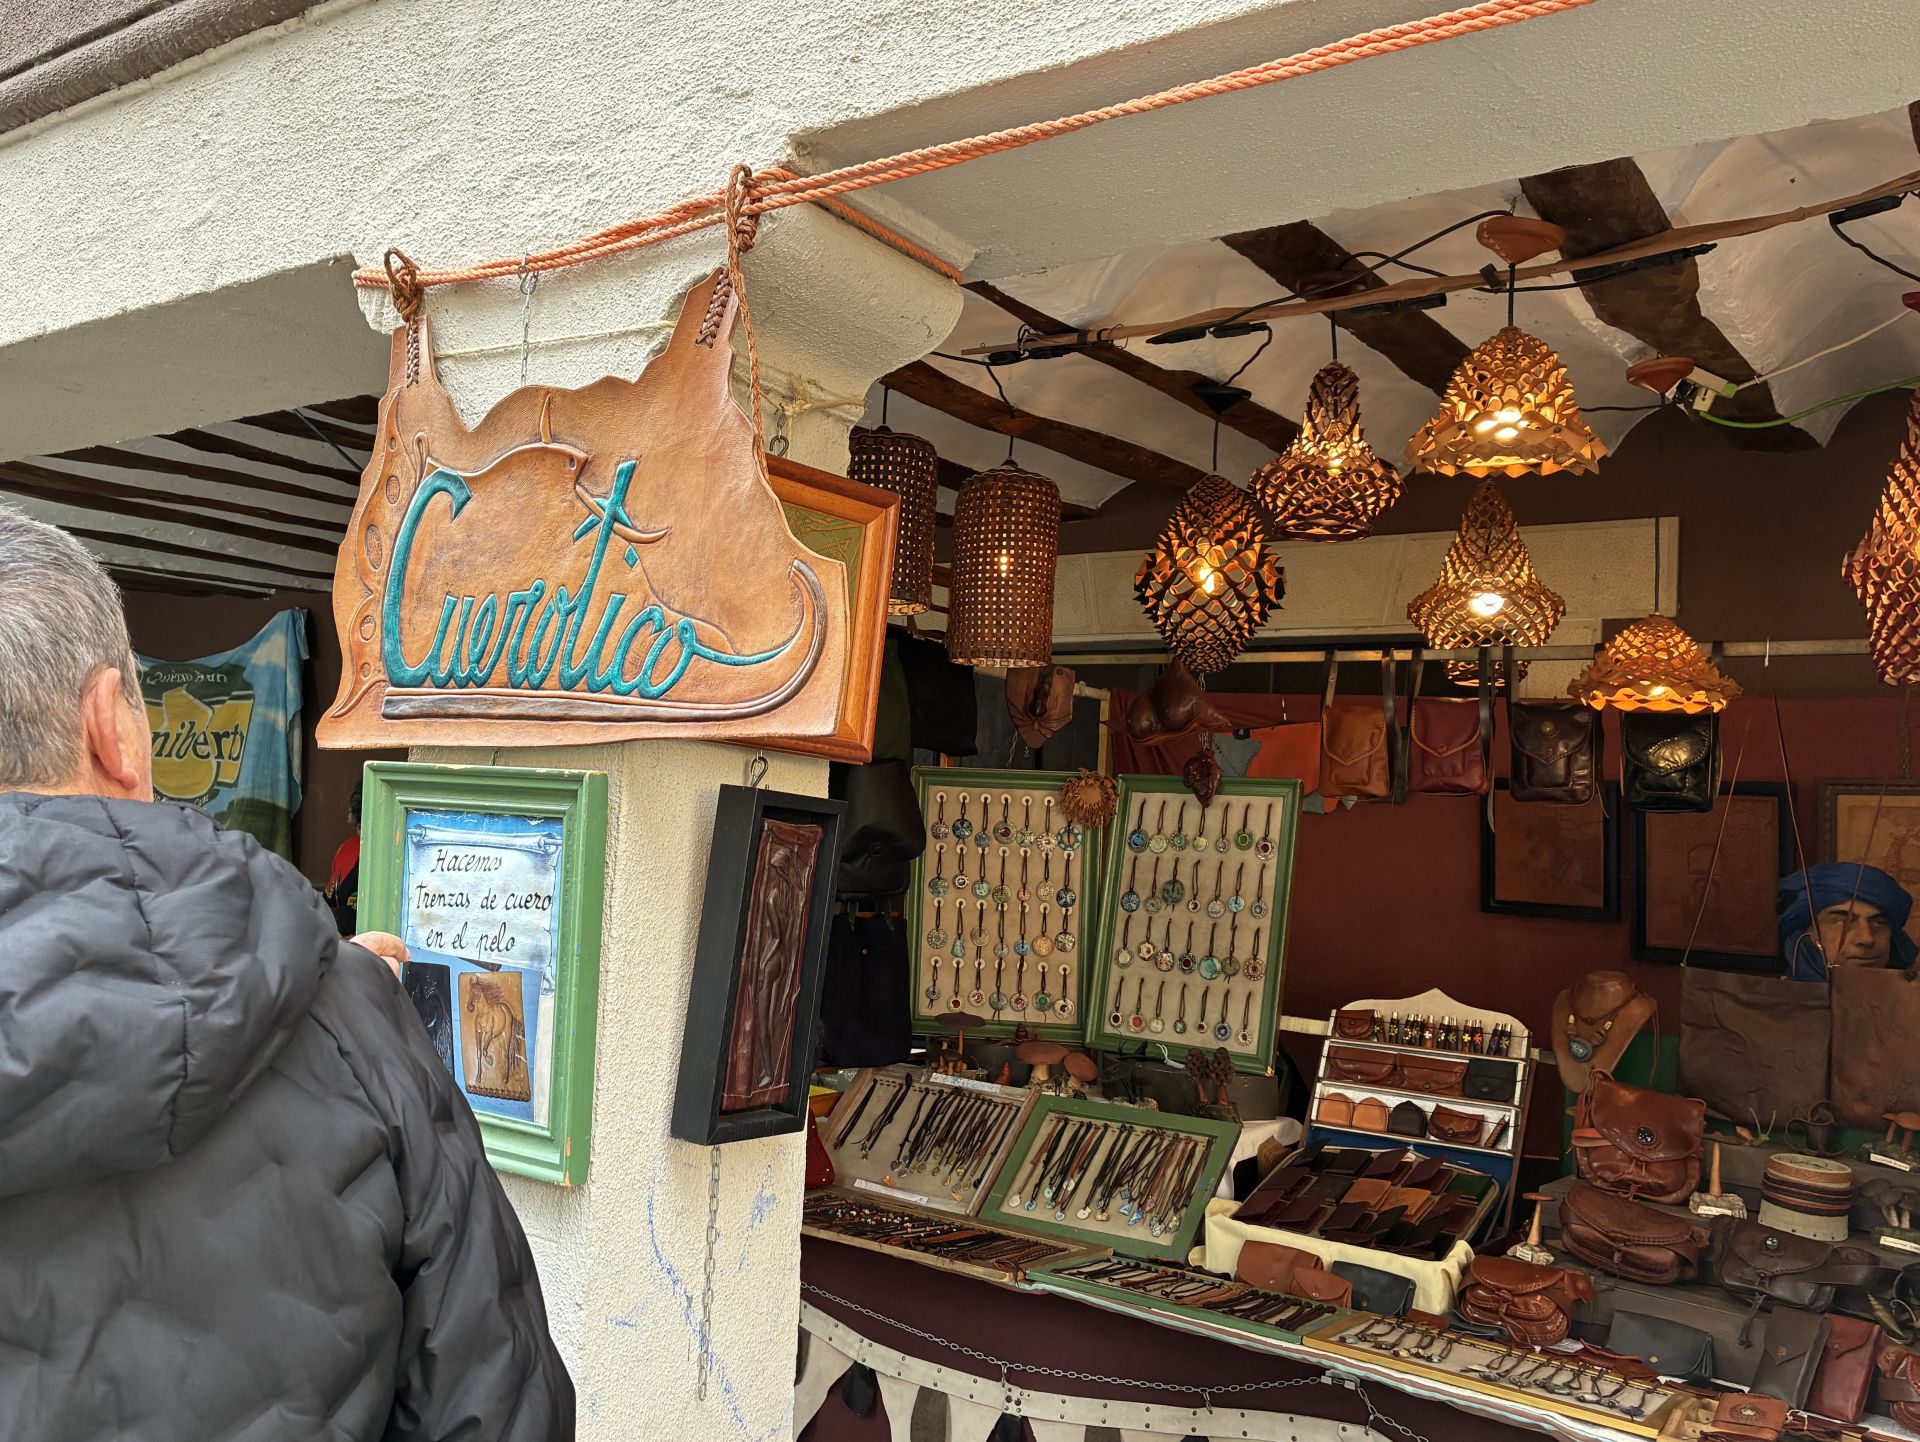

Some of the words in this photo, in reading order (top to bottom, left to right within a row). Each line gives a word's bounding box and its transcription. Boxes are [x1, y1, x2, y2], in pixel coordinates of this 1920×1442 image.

[381, 460, 792, 700] Cuerotico
[431, 849, 502, 872] Hacemos
[415, 881, 471, 909] Trenzas
[480, 888, 498, 910] de
[504, 891, 552, 911] cuero
[426, 928, 446, 949] en
[451, 921, 469, 950] el
[476, 921, 516, 959] pelo
